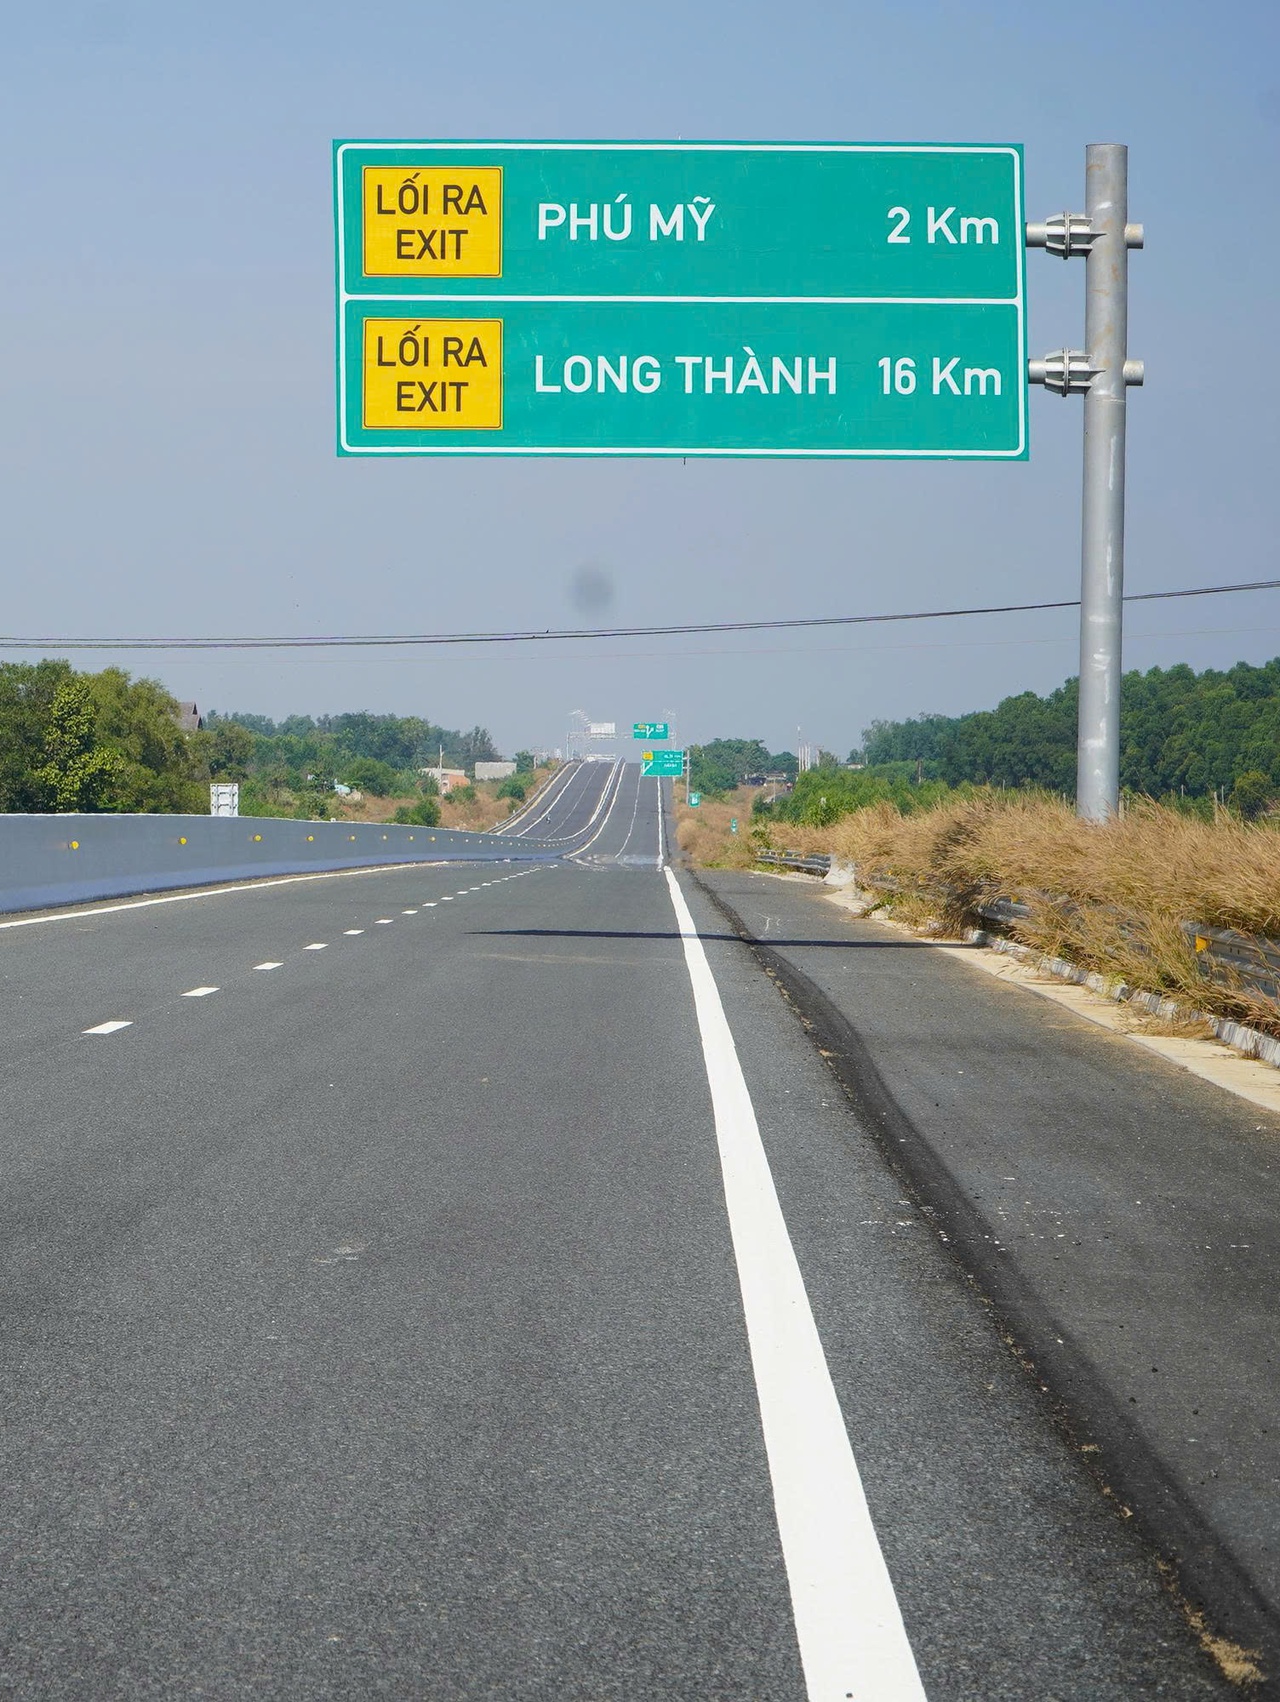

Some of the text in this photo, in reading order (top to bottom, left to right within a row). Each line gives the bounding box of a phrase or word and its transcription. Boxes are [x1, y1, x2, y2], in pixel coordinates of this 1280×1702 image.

[377, 172, 487, 215] LỐI RA
[538, 193, 716, 241] PHÚ MỸ
[887, 206, 999, 244] 2 Km
[396, 229, 469, 260] EXIT
[377, 324, 487, 367] LỐI RA
[535, 346, 837, 395] LONG THÀNH
[878, 357, 1002, 396] 16 Km
[396, 381, 469, 412] EXIT
